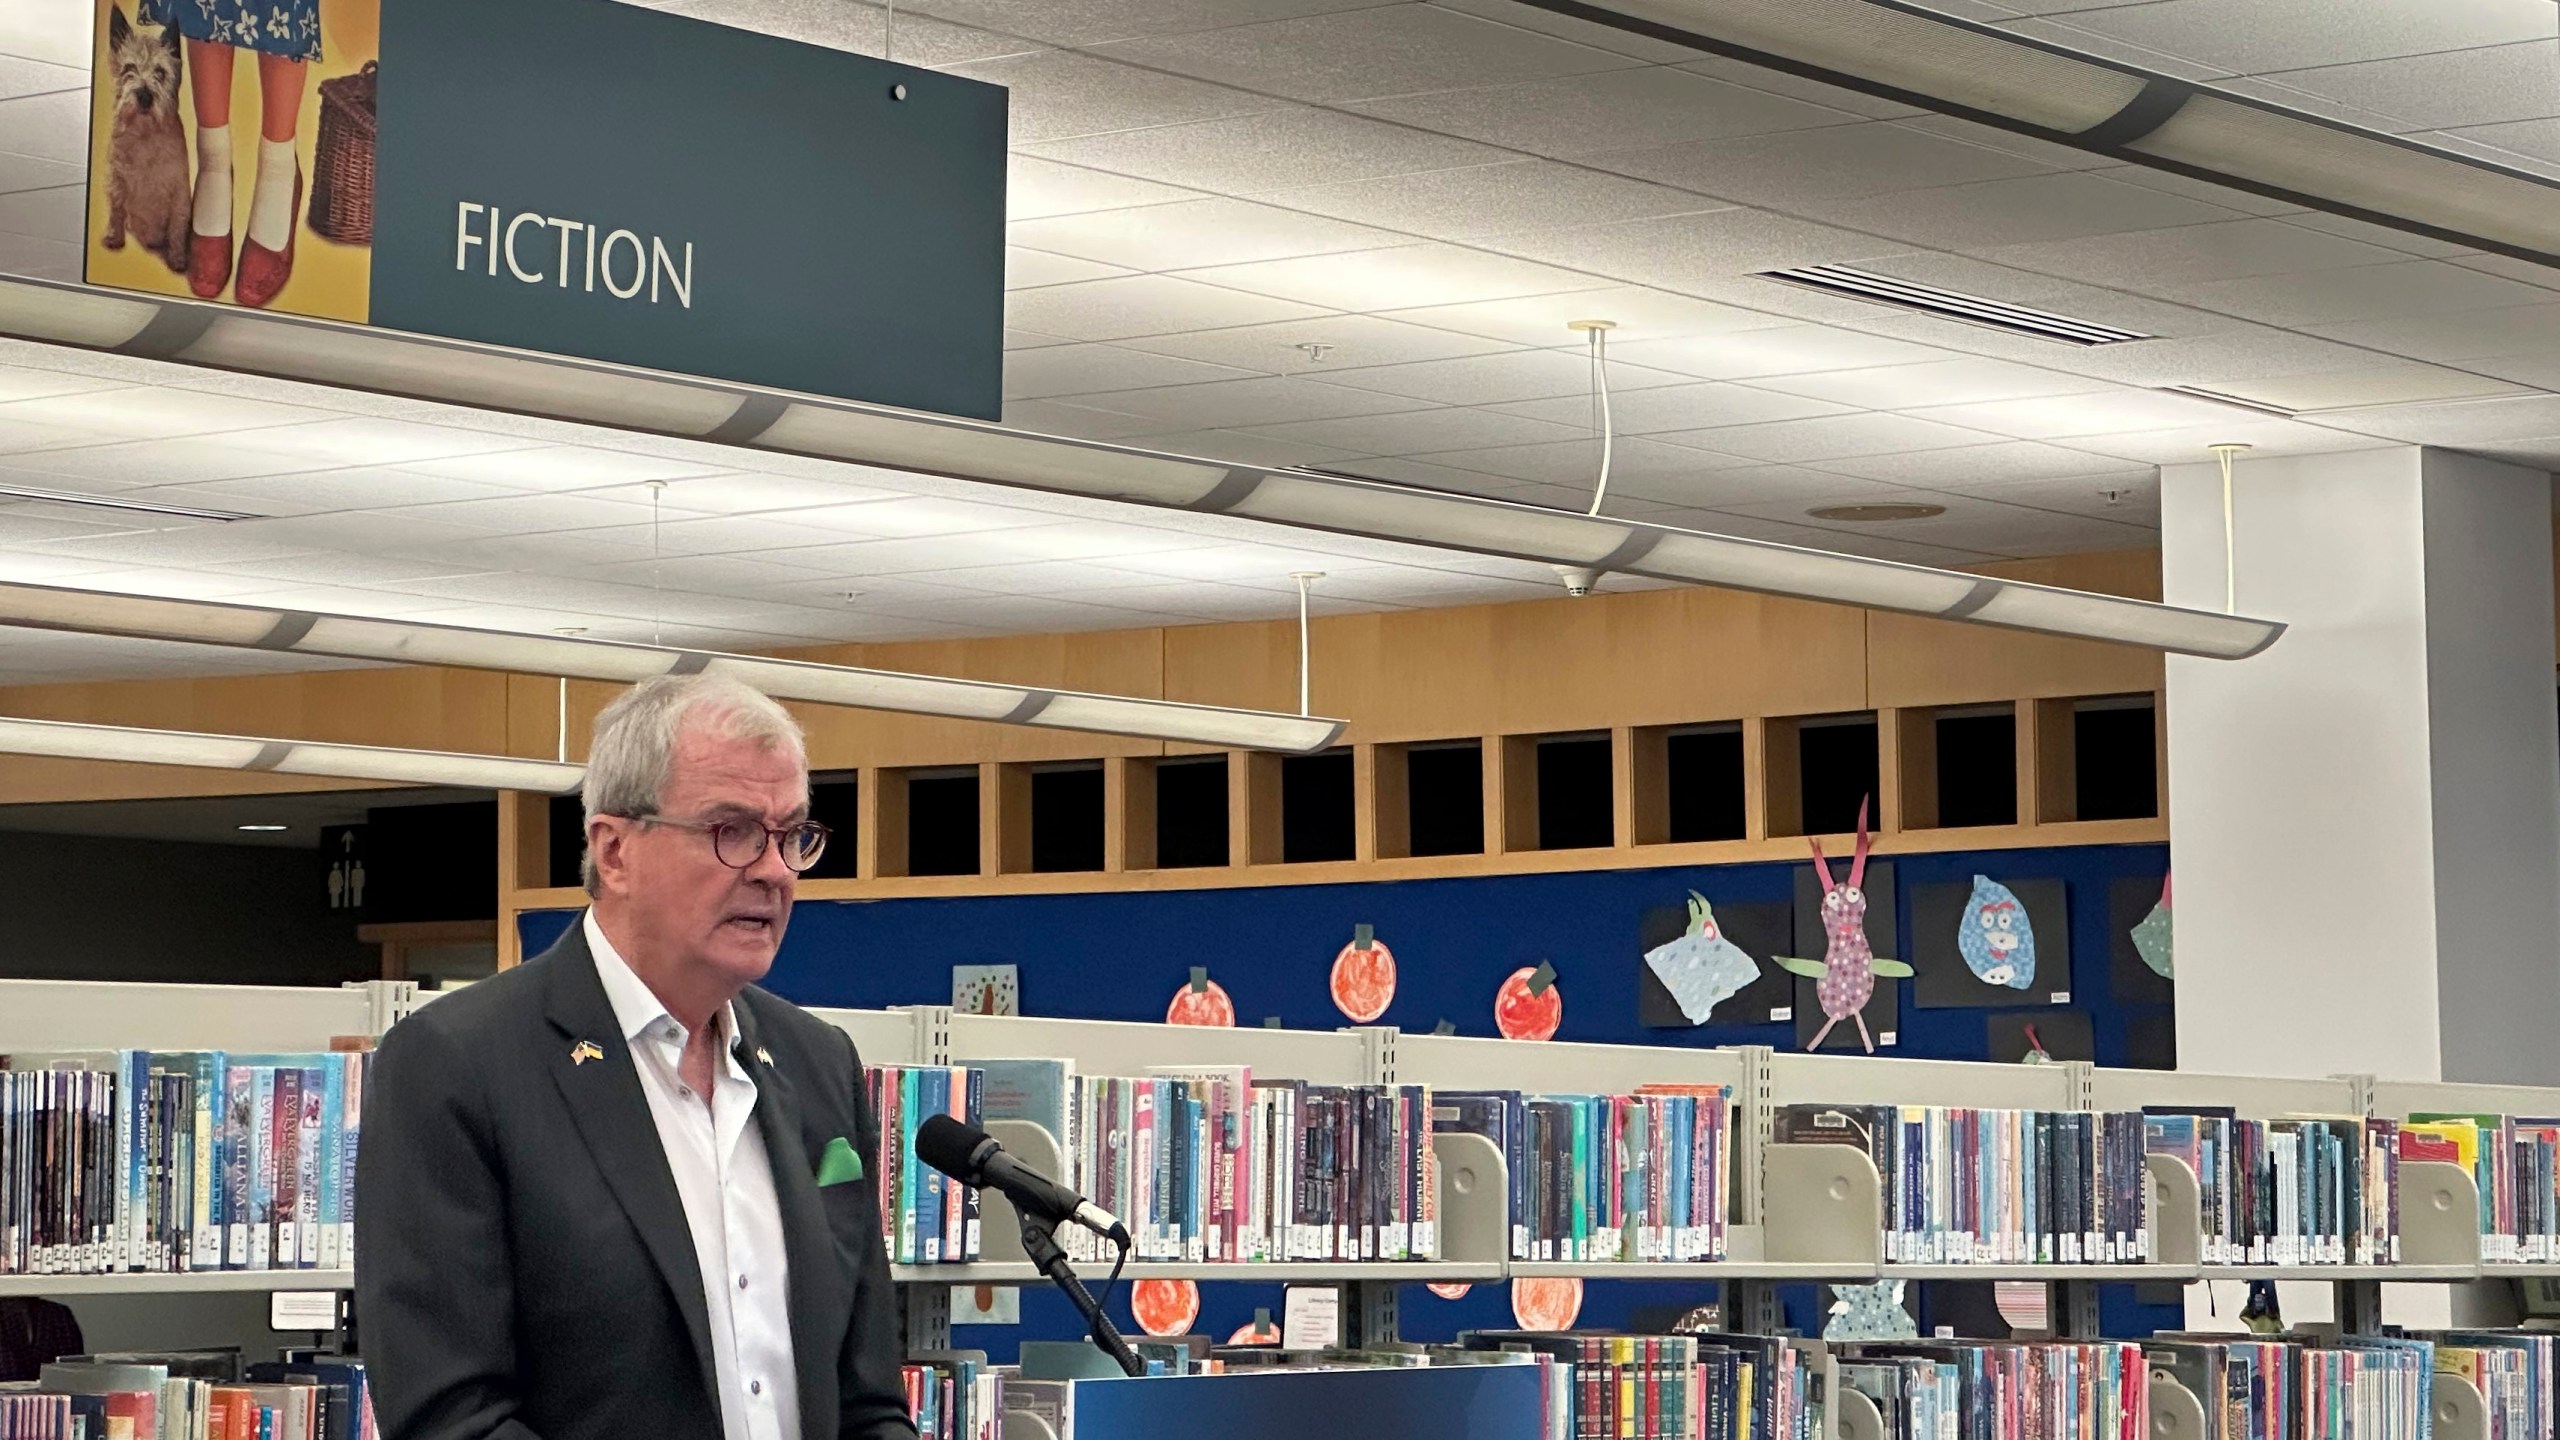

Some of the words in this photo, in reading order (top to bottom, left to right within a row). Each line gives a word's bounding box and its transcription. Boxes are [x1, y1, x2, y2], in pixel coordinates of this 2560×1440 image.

[455, 200, 695, 310] FICTION
[260, 1094, 273, 1117] EVA
[284, 1094, 298, 1116] EVA
[259, 1118, 273, 1190] EVERGREEN
[283, 1118, 298, 1190] EVERGREEN
[1299, 1125, 1307, 1160] RING
[236, 1133, 248, 1208] ALLIANA
[303, 1173, 312, 1186] NO
[304, 1161, 312, 1170] IS
[1425, 1161, 1434, 1200] FAMILY
[303, 1190, 311, 1214] HERO
